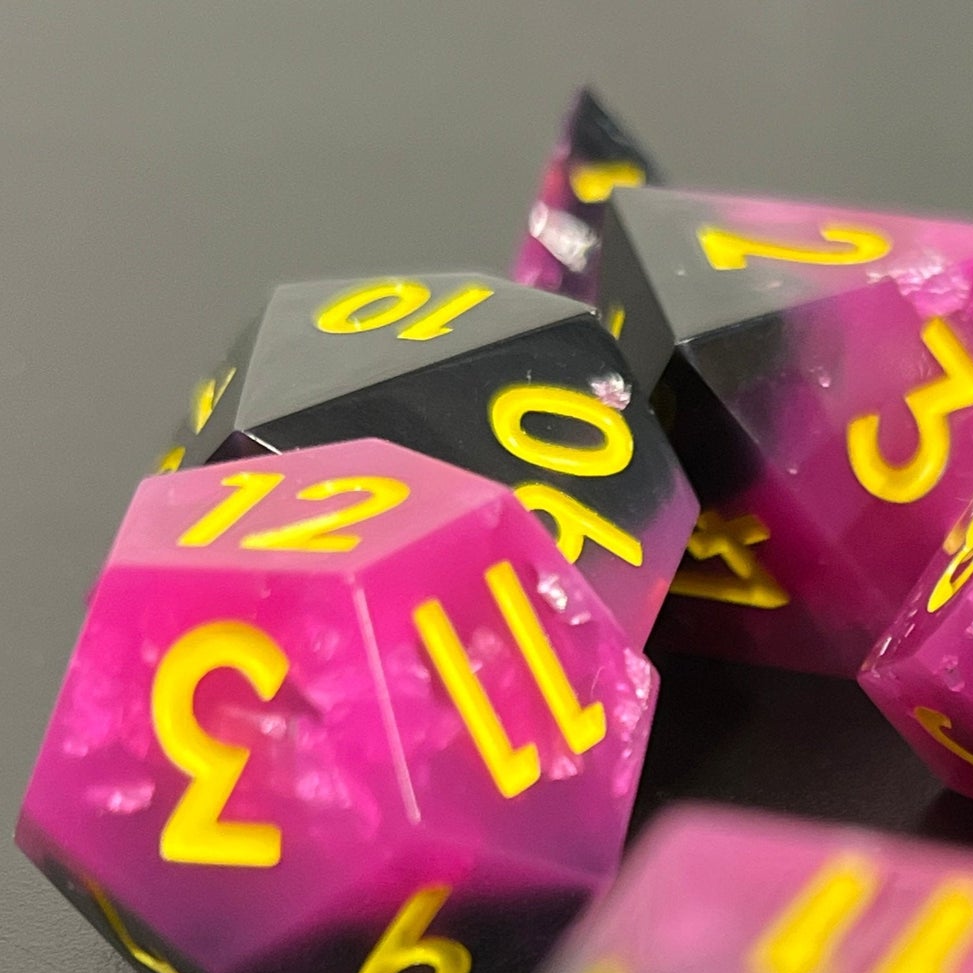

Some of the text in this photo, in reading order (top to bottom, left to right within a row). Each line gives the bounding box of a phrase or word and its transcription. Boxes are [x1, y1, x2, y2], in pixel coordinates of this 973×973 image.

[698, 224, 892, 271] 2
[313, 274, 493, 343] 10
[178, 472, 411, 553] 12
[413, 560, 607, 798] 11
[150, 620, 290, 867] 3
